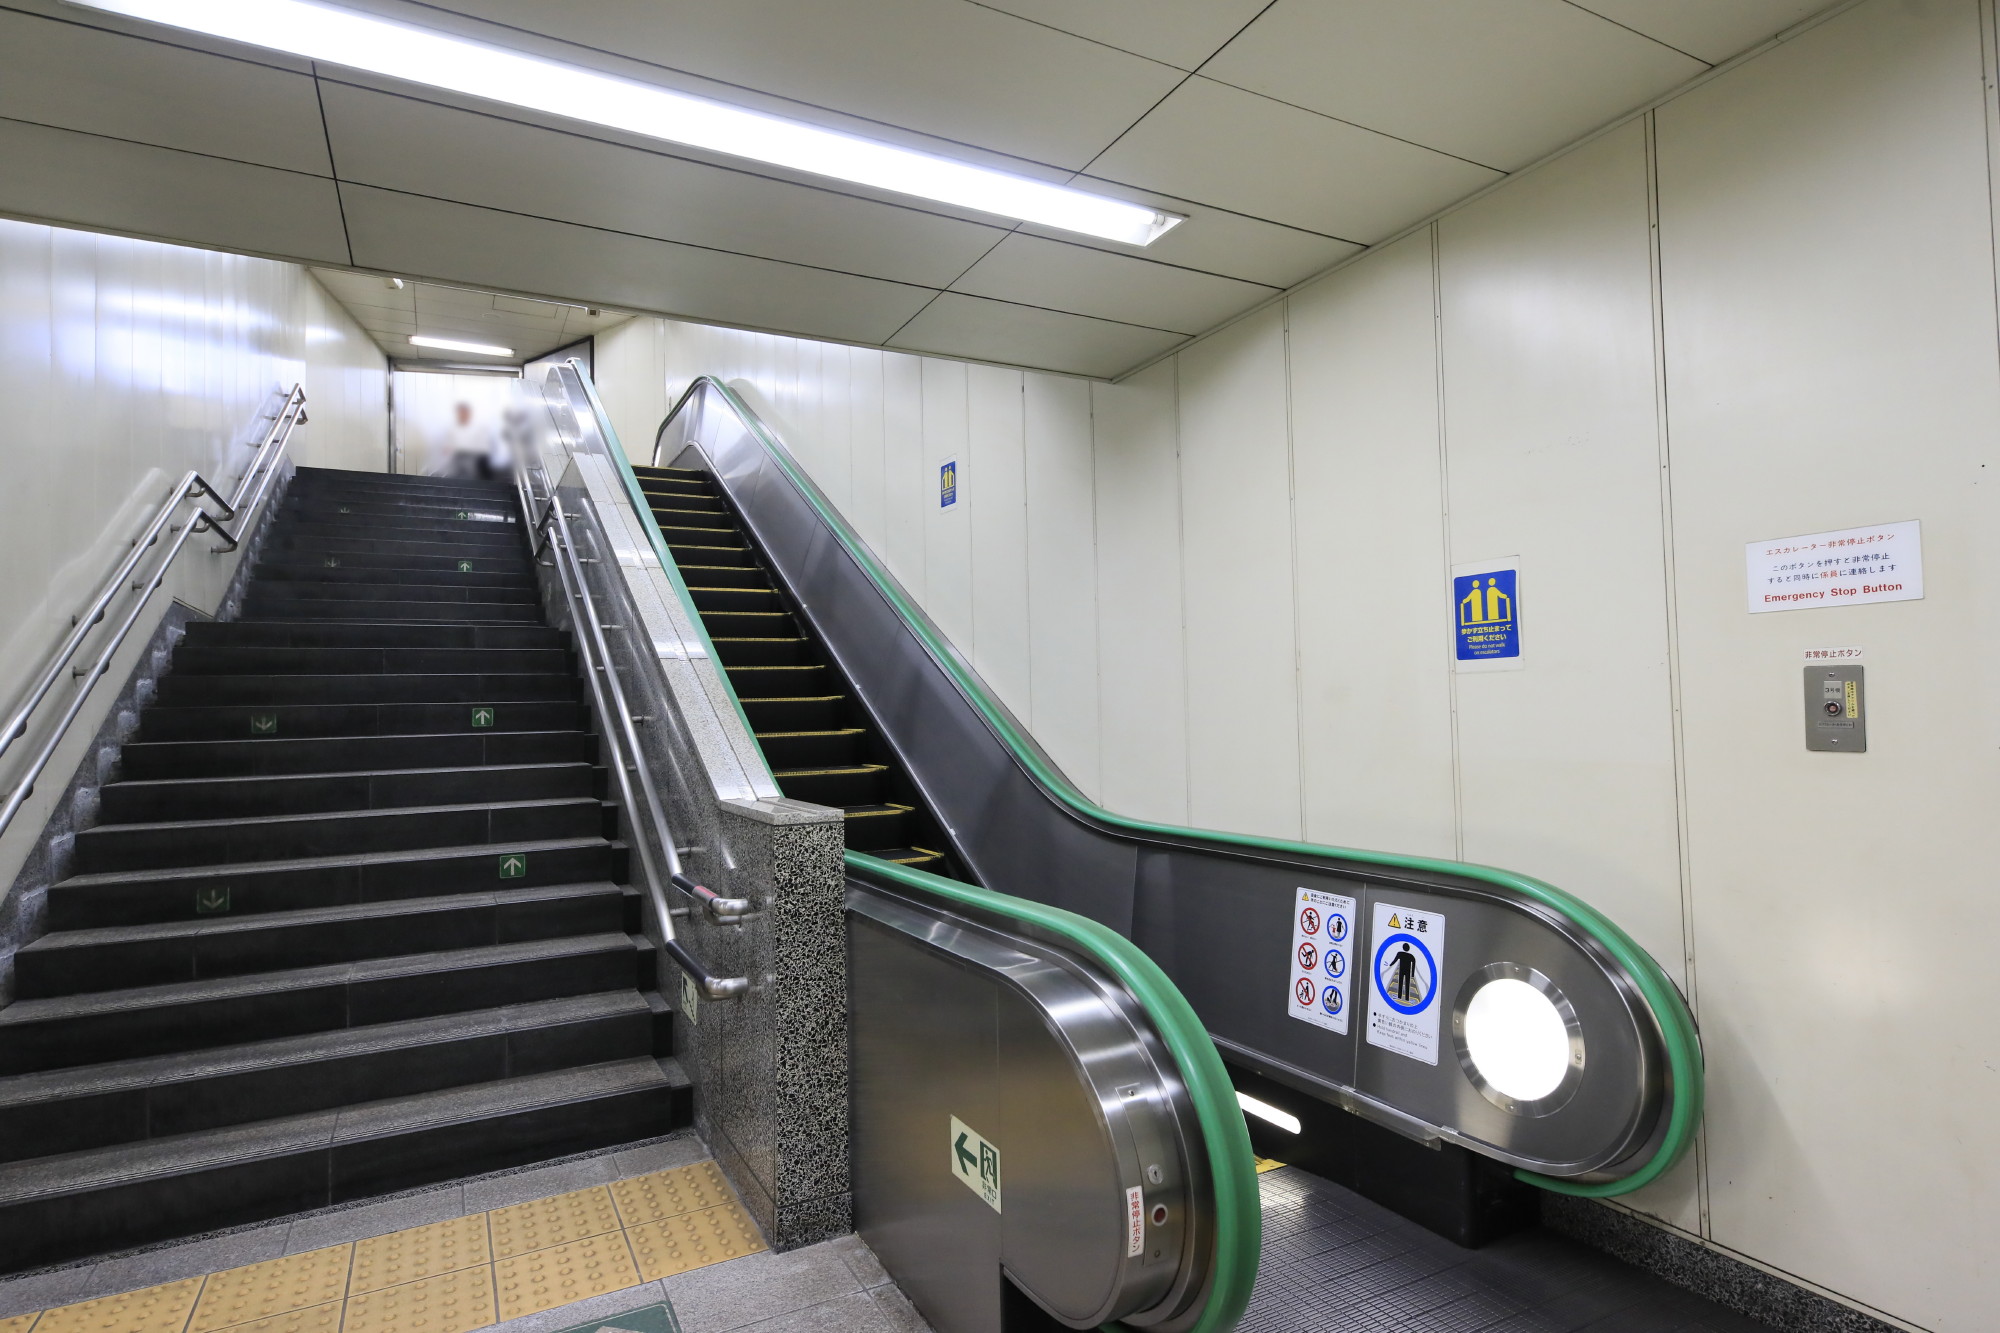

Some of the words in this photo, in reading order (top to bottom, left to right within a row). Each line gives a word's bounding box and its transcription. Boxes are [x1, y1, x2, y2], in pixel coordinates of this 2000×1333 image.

[1766, 533, 1895, 556] エスカレーター非常停止ボタン
[1773, 552, 1890, 572] このボタンを押すと非常停止
[1768, 564, 1897, 584] すると同時に係員に連絡します
[1764, 590, 1825, 603] Emergency
[1830, 586, 1857, 597] Stop
[1863, 582, 1902, 594] Button
[1804, 649, 1862, 659] 非常停止ボタン
[1404, 917, 1428, 933] 注意
[1130, 1191, 1141, 1253] 非常停止ボタン
